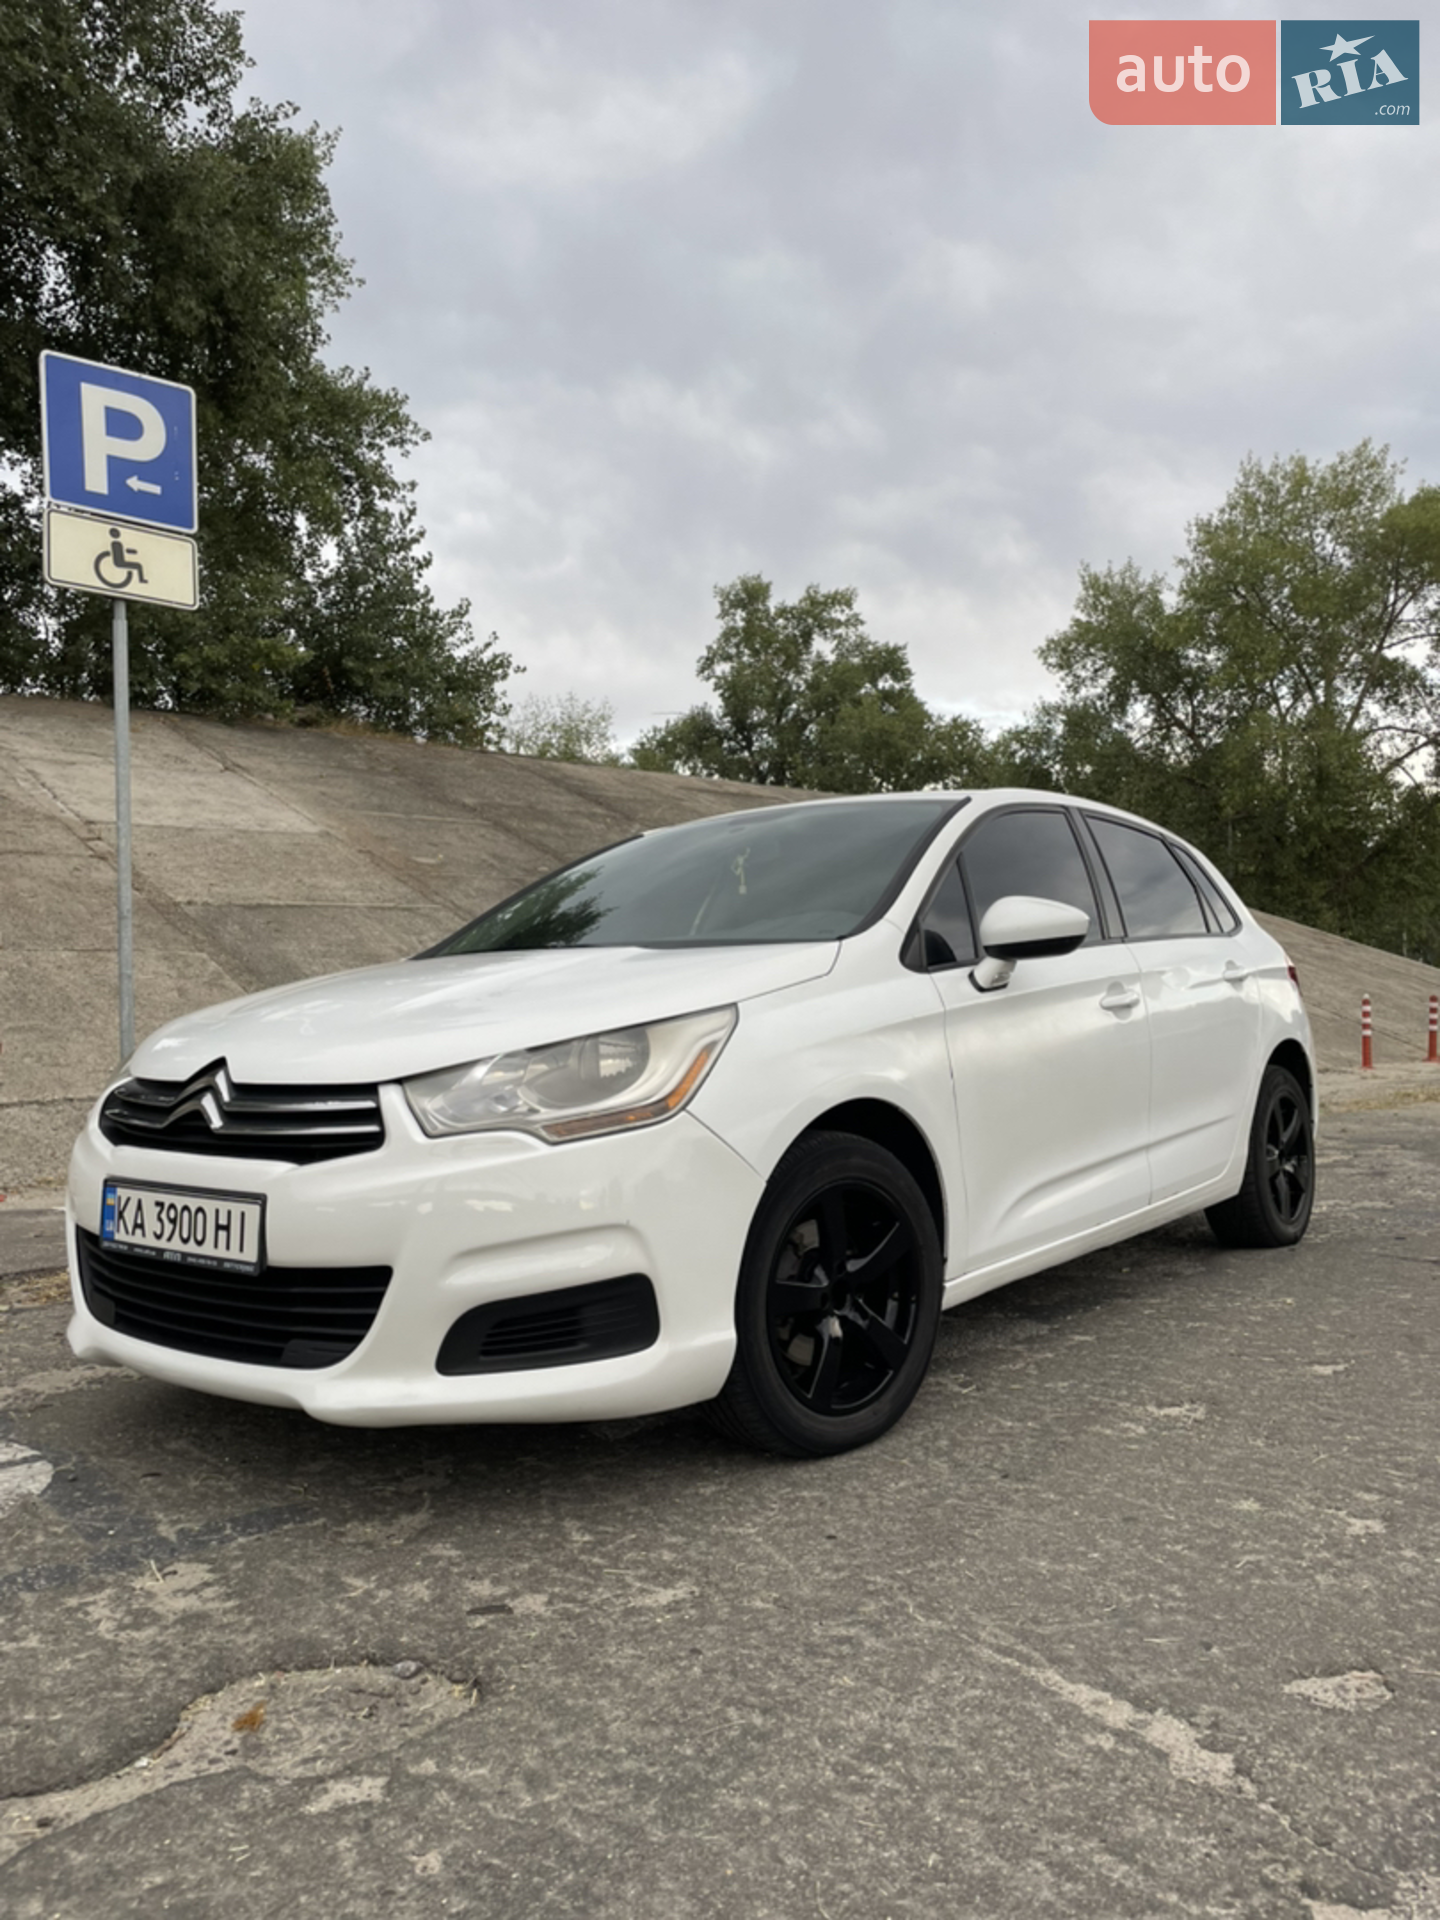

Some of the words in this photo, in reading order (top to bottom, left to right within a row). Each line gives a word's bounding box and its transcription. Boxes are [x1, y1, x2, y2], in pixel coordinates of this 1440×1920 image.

[80, 381, 167, 496] P
[115, 1194, 147, 1238] KA
[152, 1200, 207, 1247] 3900
[213, 1207, 246, 1254] HI
